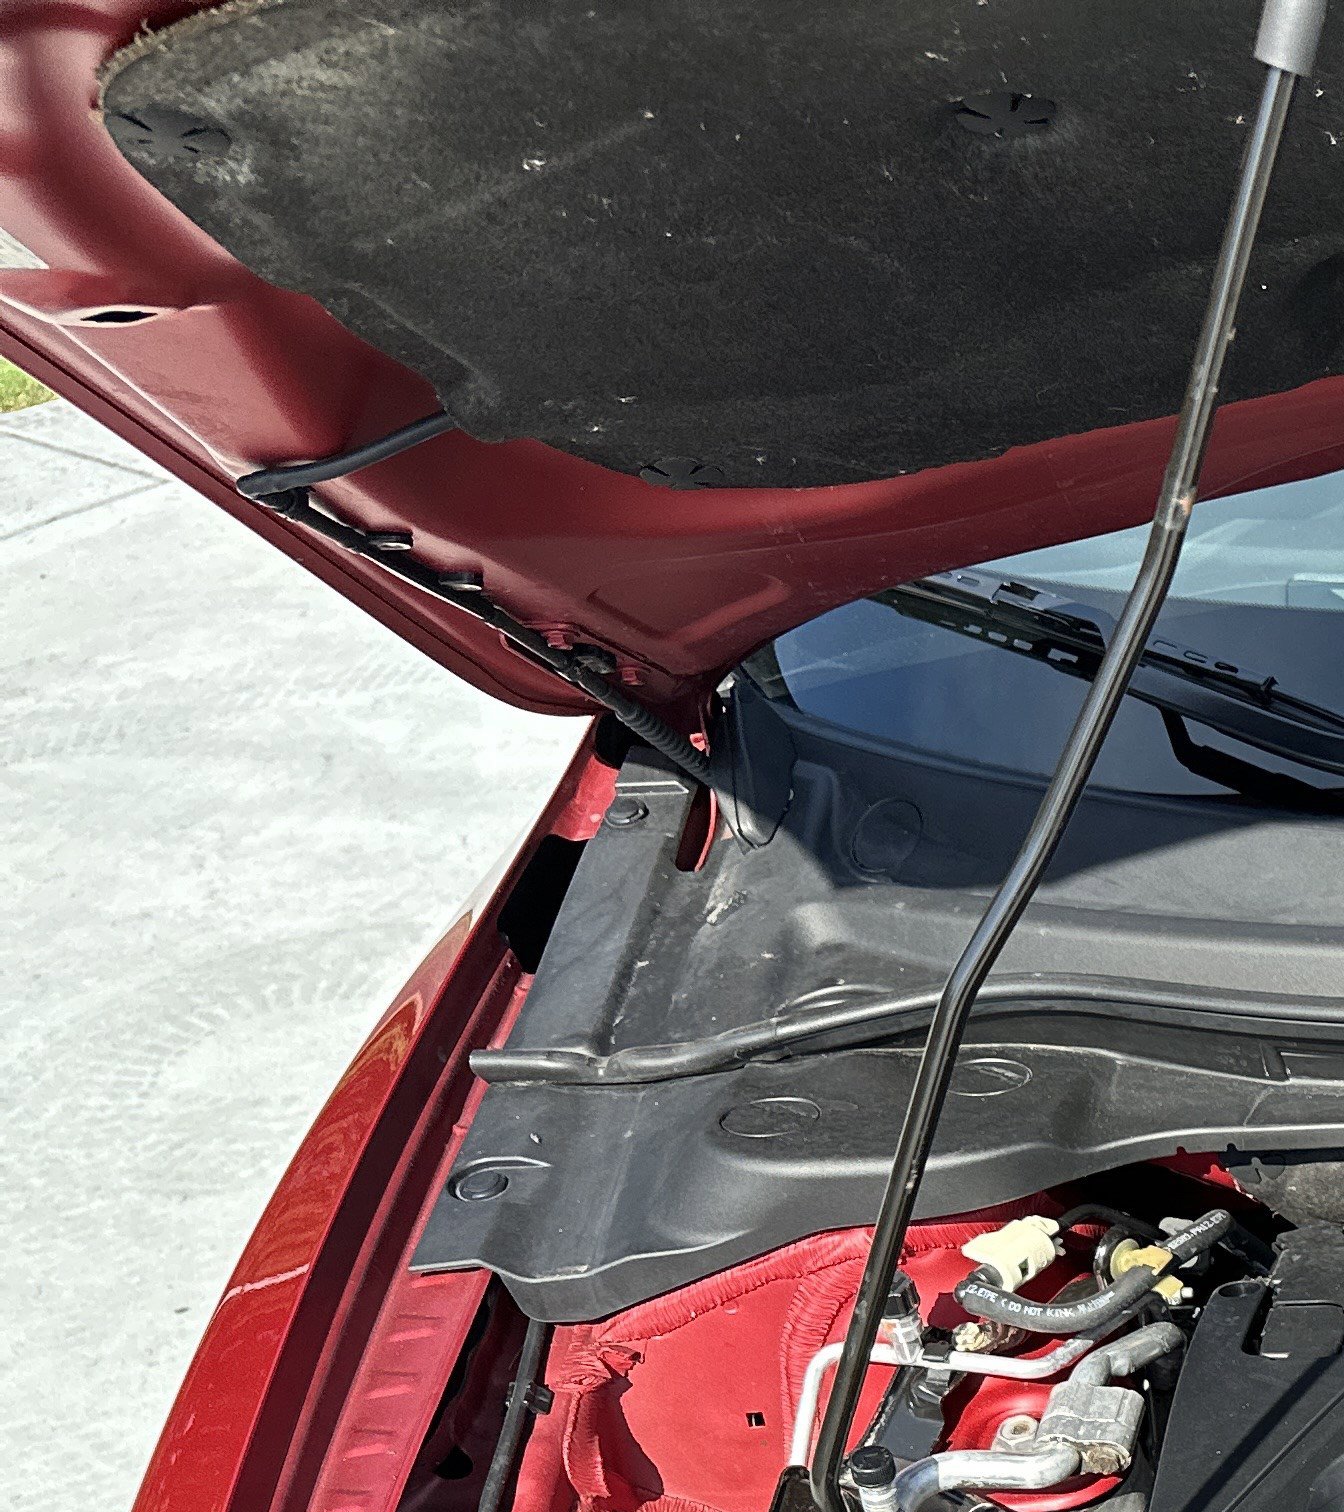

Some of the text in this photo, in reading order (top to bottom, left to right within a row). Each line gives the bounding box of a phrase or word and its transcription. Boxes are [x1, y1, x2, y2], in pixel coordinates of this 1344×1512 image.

[1008, 1302, 1021, 1313] DO
[1023, 1306, 1043, 1317] NOT
[1046, 1307, 1075, 1318] KINK
